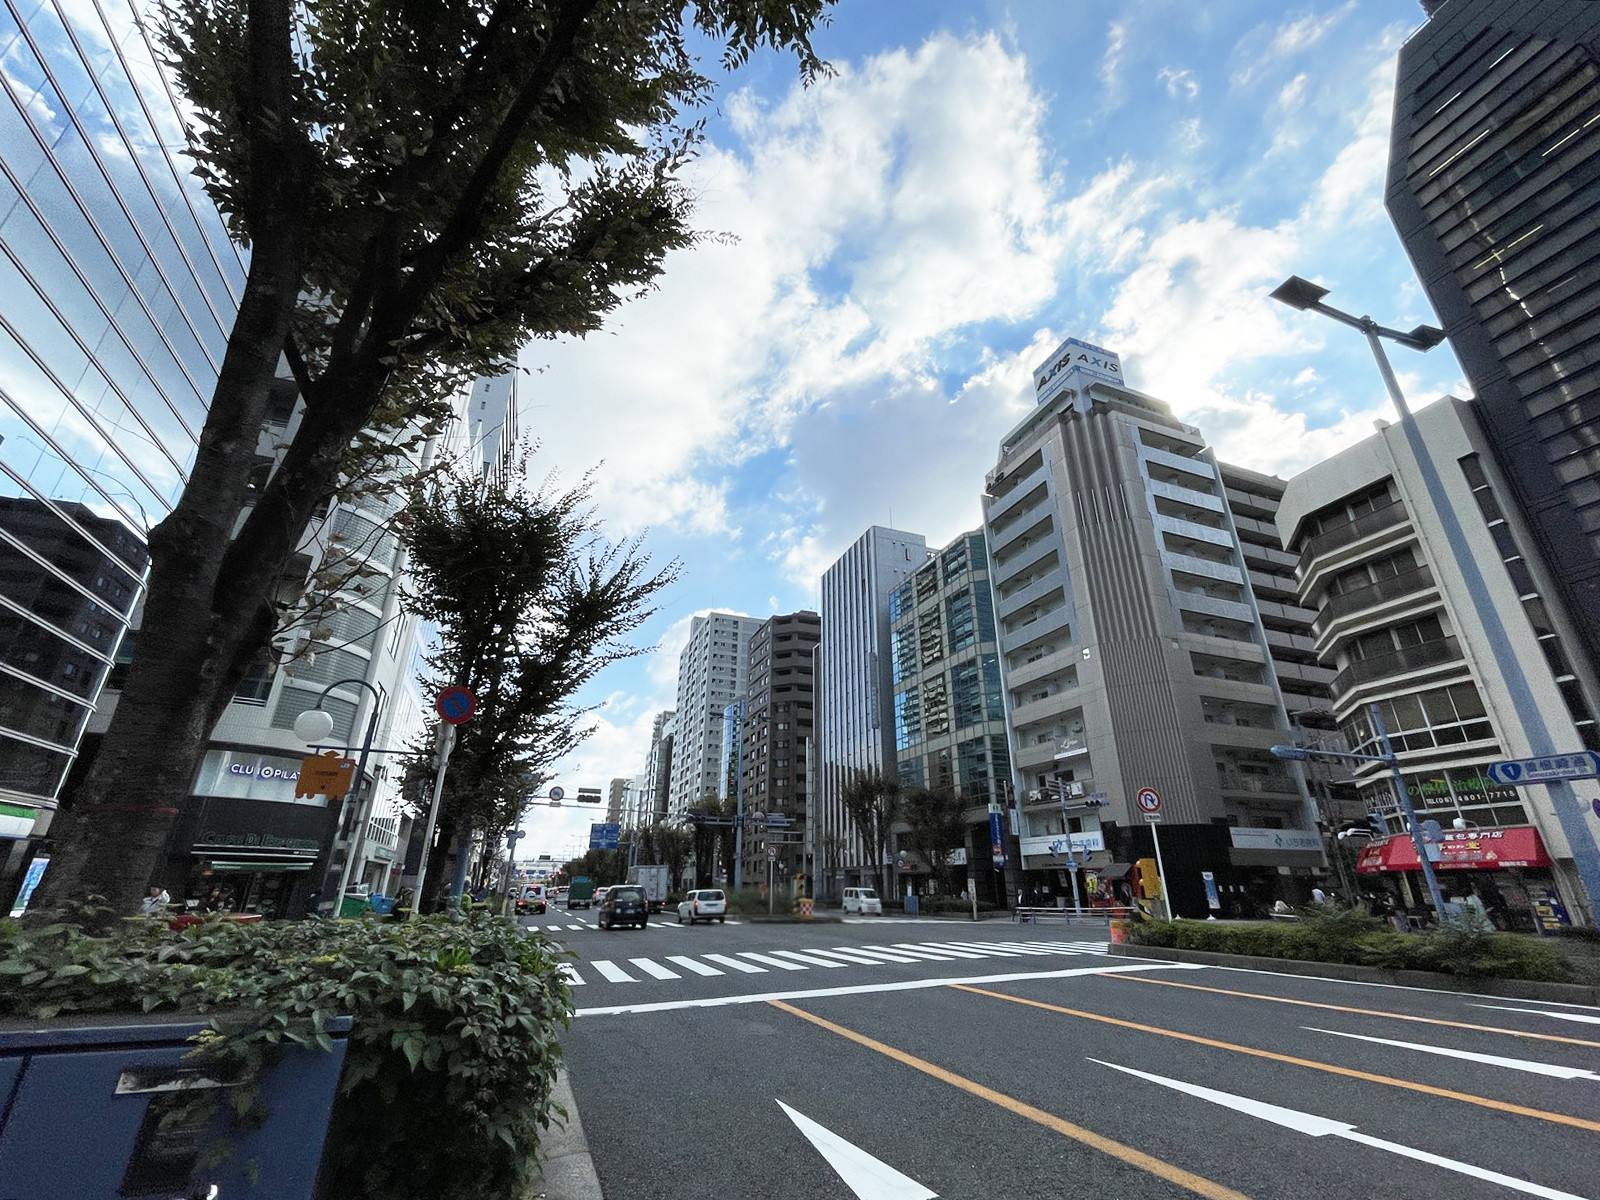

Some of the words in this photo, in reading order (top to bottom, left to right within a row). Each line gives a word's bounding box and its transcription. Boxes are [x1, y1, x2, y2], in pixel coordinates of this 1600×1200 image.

[1077, 353, 1119, 372] AXIS
[1037, 353, 1071, 391] AXIS
[231, 764, 261, 775] CLU
[1507, 766, 1515, 776] 1
